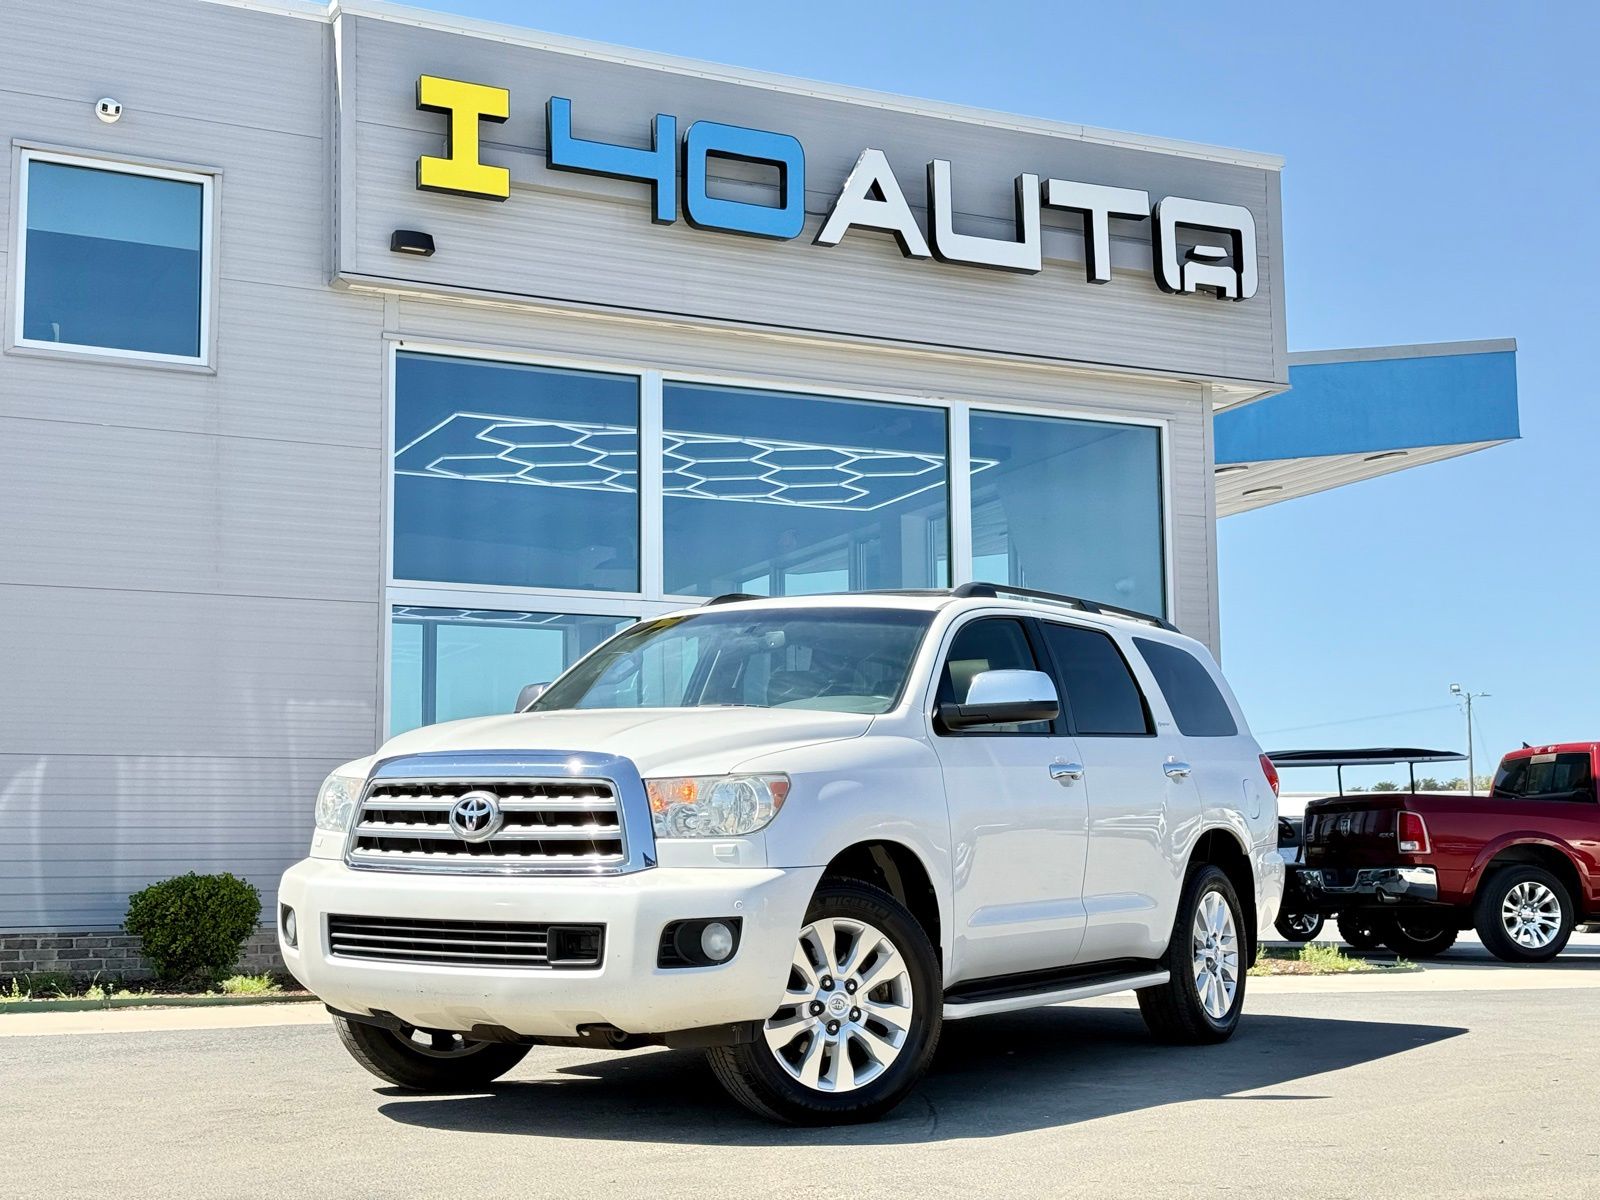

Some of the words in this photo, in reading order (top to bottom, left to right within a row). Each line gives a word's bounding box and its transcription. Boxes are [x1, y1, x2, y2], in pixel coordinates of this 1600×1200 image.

[416, 74, 510, 201] I
[546, 97, 805, 240] 40
[812, 147, 1258, 301] AUTO
